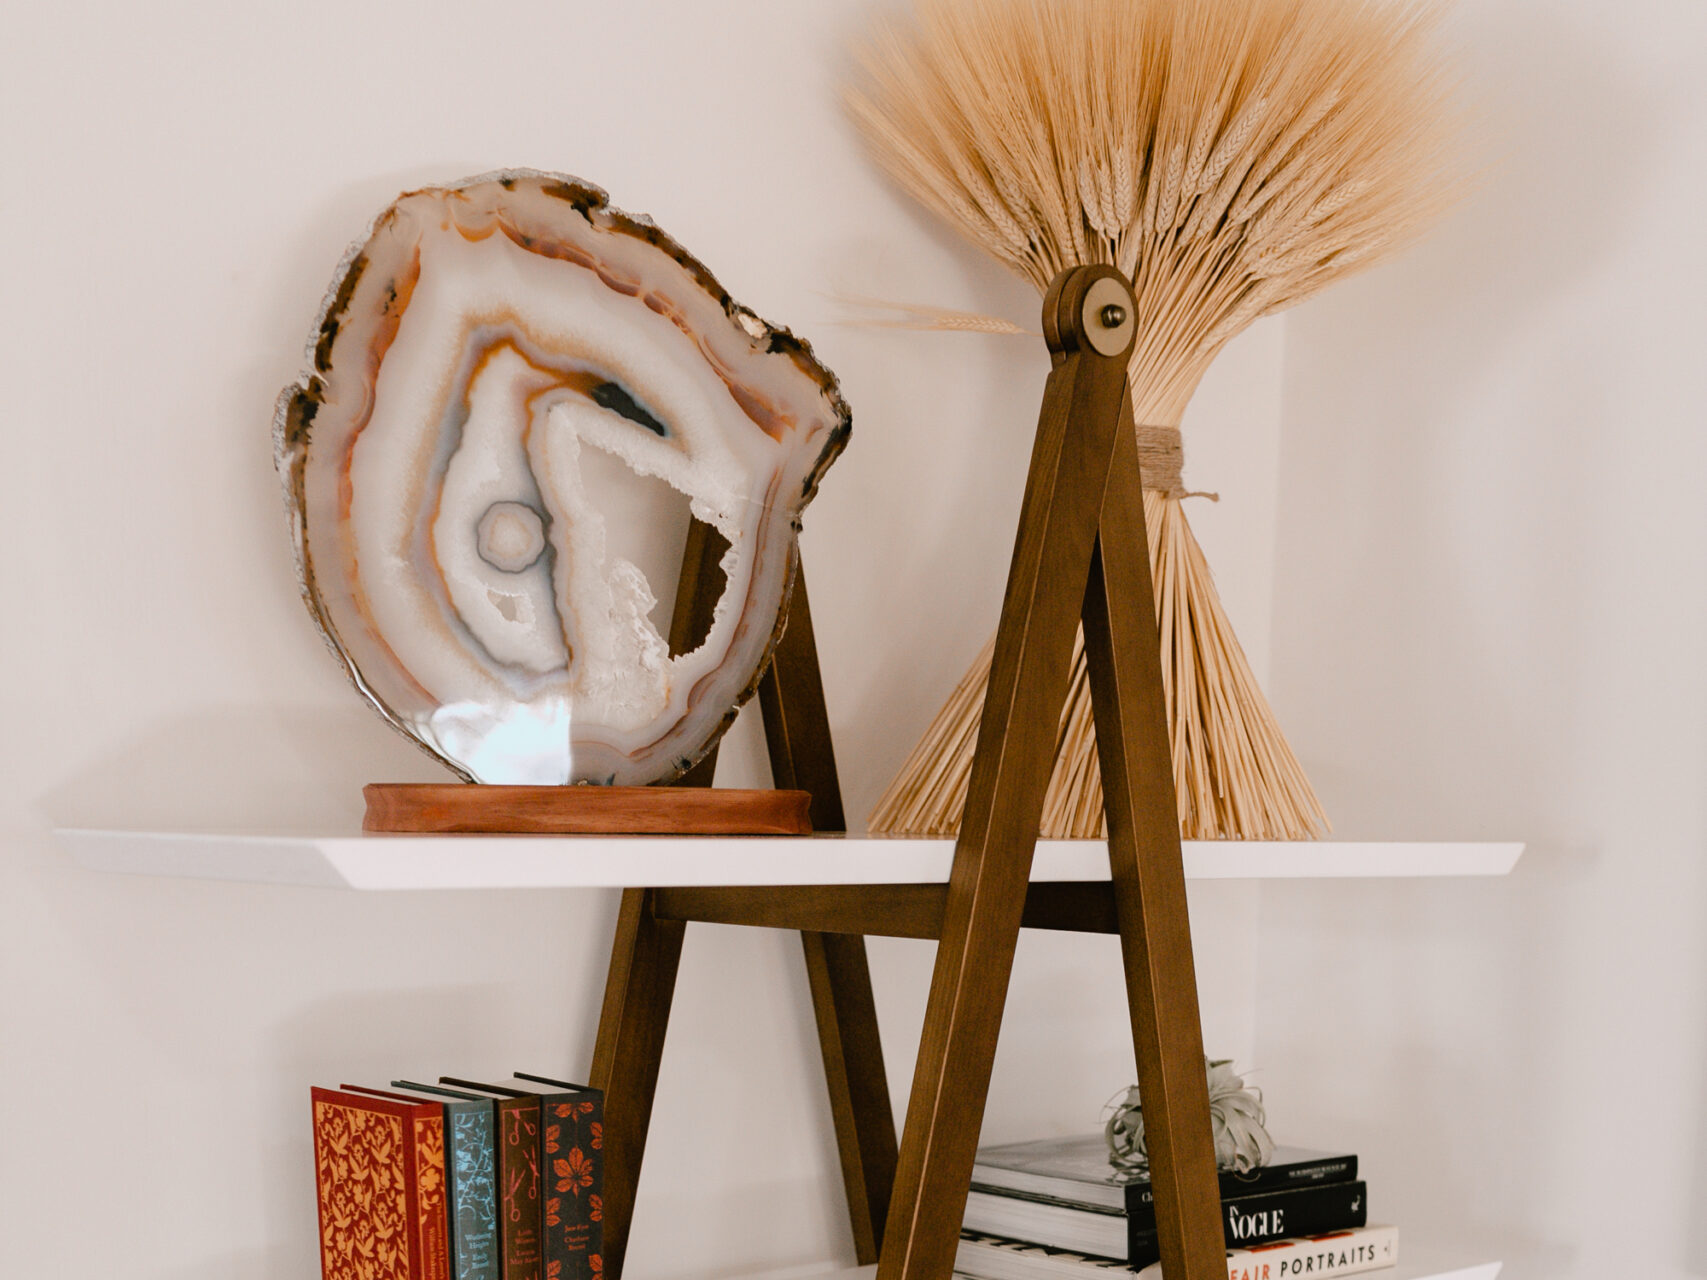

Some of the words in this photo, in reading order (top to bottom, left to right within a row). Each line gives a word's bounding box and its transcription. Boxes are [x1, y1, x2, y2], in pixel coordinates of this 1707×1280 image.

[1229, 1205, 1239, 1217] IN
[1229, 1209, 1284, 1240] VOGUE
[1280, 1244, 1375, 1278] PORTRAITS
